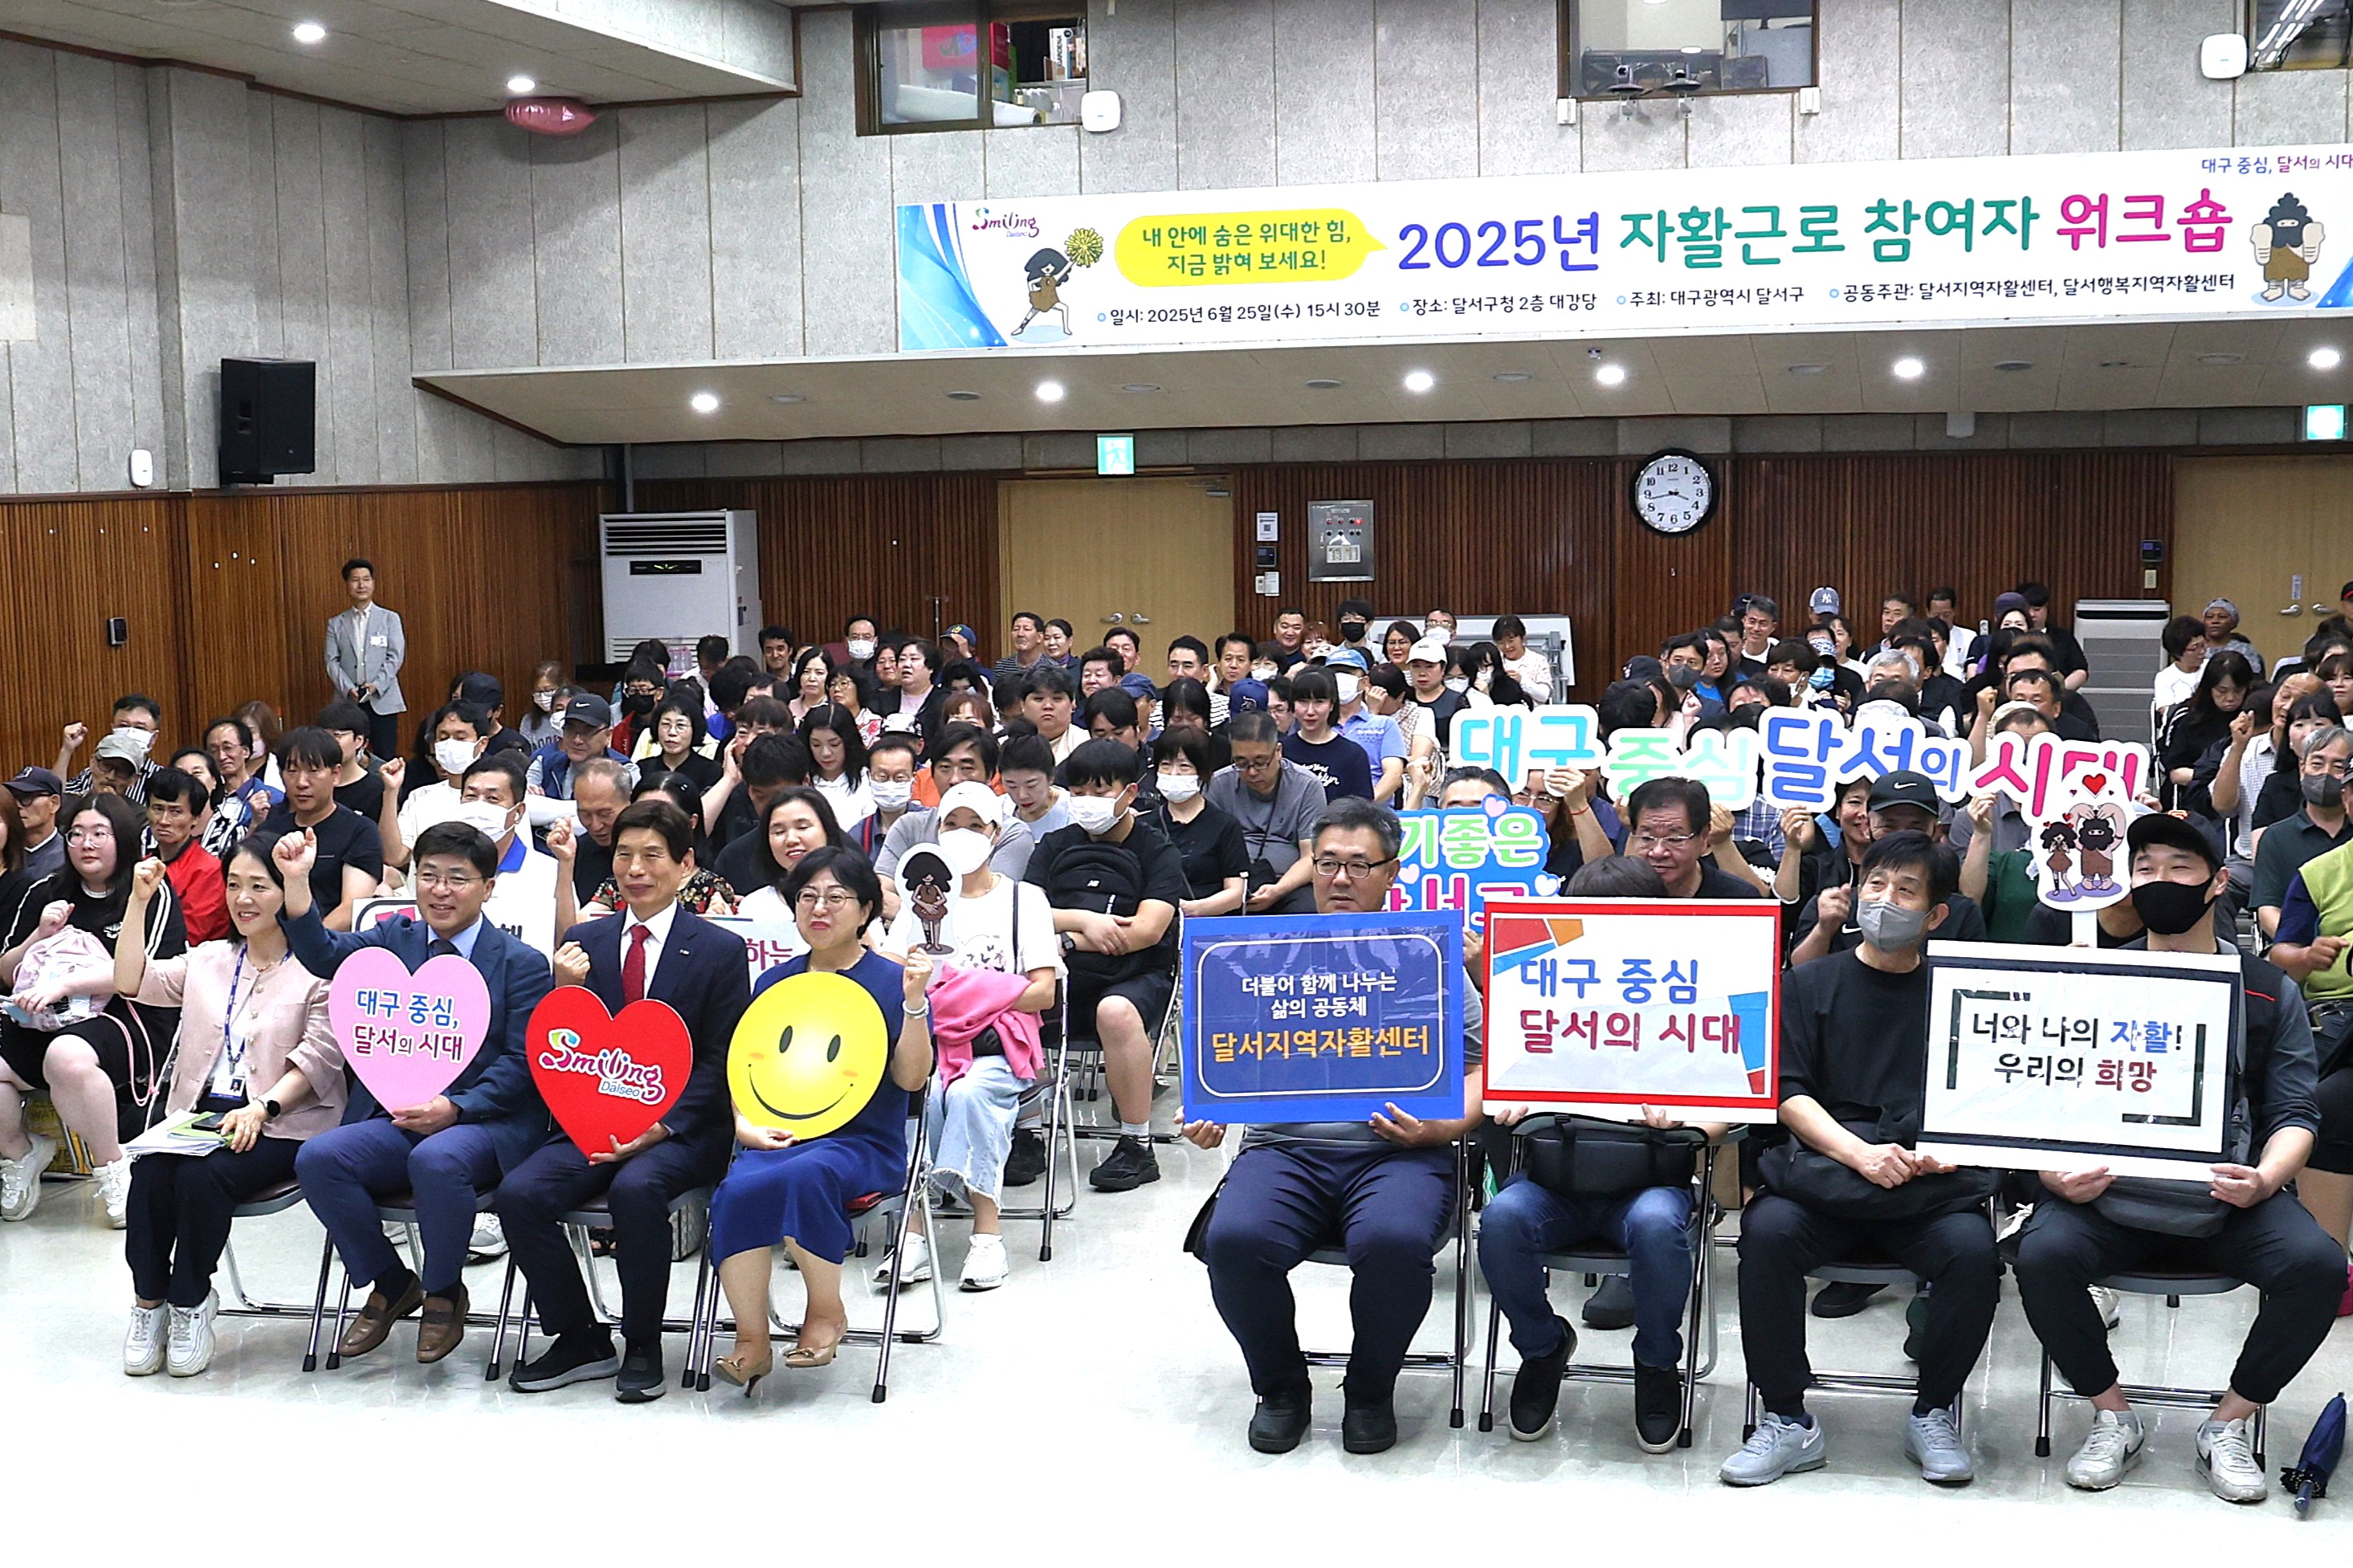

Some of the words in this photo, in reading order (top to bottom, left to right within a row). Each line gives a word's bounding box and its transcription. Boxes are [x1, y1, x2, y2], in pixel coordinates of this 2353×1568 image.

[2201, 157, 2233, 173] 대구
[2237, 157, 2272, 174] 중심,
[2278, 155, 2320, 173] 달서의
[972, 207, 1040, 238] Smiling
[1143, 227, 1161, 247] 내
[1168, 226, 1207, 249] 안에
[1213, 224, 1253, 247] 숨은
[1259, 222, 1320, 243] 위대한
[1327, 220, 1351, 243] 힘,
[1398, 211, 1600, 272] 2025년
[1619, 205, 1846, 270] 자활근로
[1863, 195, 2041, 263] 참여자
[2056, 187, 2234, 252] 워크숍
[1168, 254, 1207, 276] 지금
[1213, 252, 1251, 275] 밝혀
[1258, 250, 1325, 271] 보세요!
[1629, 291, 1666, 307] 주최:
[1670, 288, 1751, 307] 대구광역시
[1756, 287, 1805, 305] 달서구
[1843, 283, 1914, 303] 공동주관:
[1919, 279, 2057, 300] 달서지역자활센터,
[2063, 273, 2234, 296] 달서행복지역자활센터
[1110, 308, 1144, 326] 일시:
[1148, 306, 1203, 324] 2025년
[1207, 305, 1232, 323] 6월
[1237, 303, 1301, 321] 25일(수)
[1307, 302, 1340, 317] 15시
[1344, 300, 1380, 317] 30분
[1413, 299, 1448, 316] 장소:
[1452, 295, 1514, 315] 달서구청
[1519, 295, 1545, 312] 2층
[1549, 293, 1597, 312] 대강당
[1668, 463, 1678, 473] 12
[1684, 466, 1689, 474] 1
[1692, 475, 1701, 485] 2
[1646, 477, 1656, 487] 10
[1695, 488, 1703, 498] 3
[1644, 490, 1652, 499] 9
[1691, 501, 1699, 511] 4
[1647, 503, 1656, 512] 8
[1657, 513, 1665, 522] 7
[1670, 515, 1678, 524] 6
[1683, 511, 1691, 520] 5
[1460, 715, 1596, 784] 대구
[1609, 735, 1749, 802] 중심
[1767, 716, 1961, 803] 달서의
[1242, 975, 1295, 996] 더불어
[1300, 973, 1337, 995] 함께
[1342, 971, 1397, 993] 나누는
[1520, 958, 1601, 999] 대구
[1616, 959, 1698, 1004] 중심
[357, 990, 400, 1018] 대구
[408, 994, 458, 1029] 중심,
[1270, 999, 1307, 1020] 삶의
[1311, 996, 1368, 1018] 공동체
[355, 1025, 413, 1055] 달서의
[418, 1033, 463, 1061] 시대
[1212, 1024, 1429, 1063] 달서지역자활센터
[1519, 1009, 1640, 1054] 달서의
[1658, 1013, 1741, 1054] 시대
[1972, 1012, 2032, 1045] 너와
[2042, 1016, 2099, 1049] 나의
[2110, 1020, 2183, 1054] 자활!
[541, 1031, 663, 1102] Smiling
[1994, 1053, 2084, 1089] 우리의
[2094, 1058, 2158, 1094] 희망
[601, 1081, 641, 1098] Dalseo
